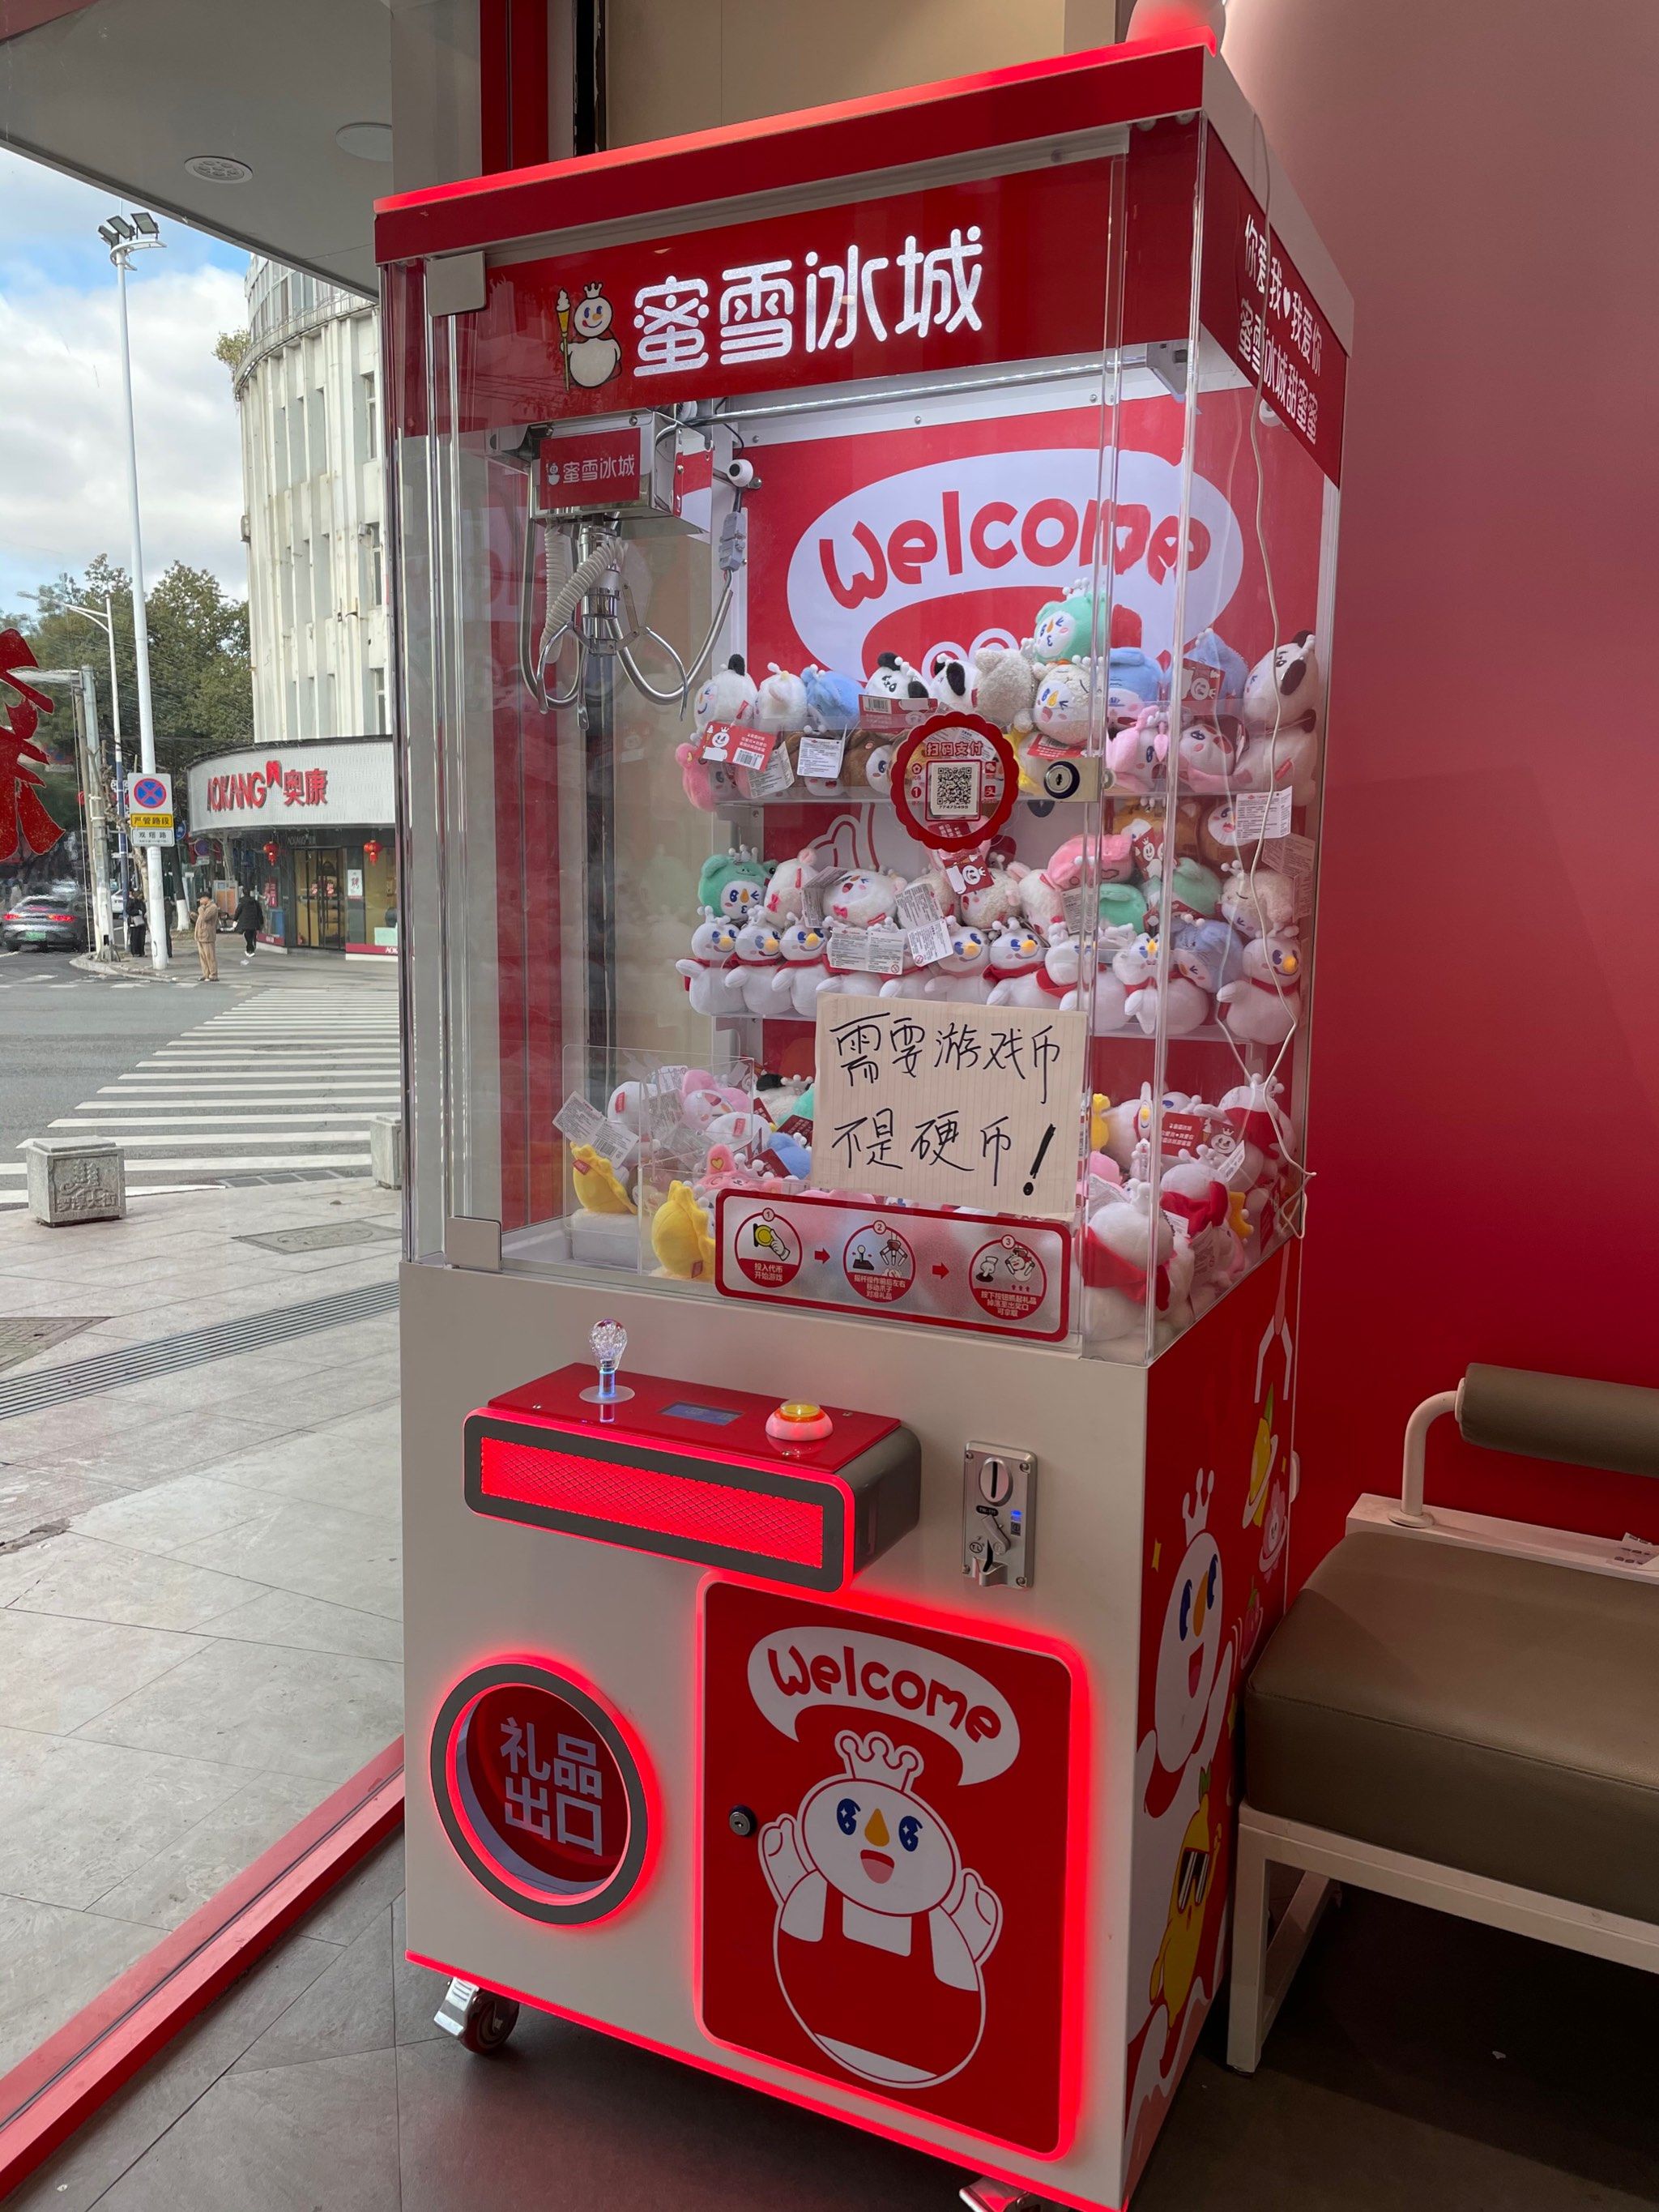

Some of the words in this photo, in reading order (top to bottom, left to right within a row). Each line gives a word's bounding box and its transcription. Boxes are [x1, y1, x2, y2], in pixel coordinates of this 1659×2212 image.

[633, 225, 983, 378] 蜜雪冰城
[562, 453, 636, 485] 蜜雪冰城
[819, 490, 1212, 610] Welcome
[926, 741, 983, 758] 扫码支付
[284, 768, 328, 807] 奥康
[134, 816, 169, 825] 严管路段
[829, 1012, 1060, 1104] 需要游戏币
[831, 1107, 1057, 1197] 不是硬币!
[754, 1262, 783, 1273] 投入代币
[754, 1270, 783, 1282] 开始游戏
[854, 1275, 906, 1288] 摇杆操作前后左右
[866, 1283, 893, 1293] 移动爪子
[866, 1291, 893, 1300] 对准礼品
[767, 1644, 1002, 1744] Welcome
[500, 1716, 603, 1800] 礼品
[504, 1776, 603, 1856] 出口
